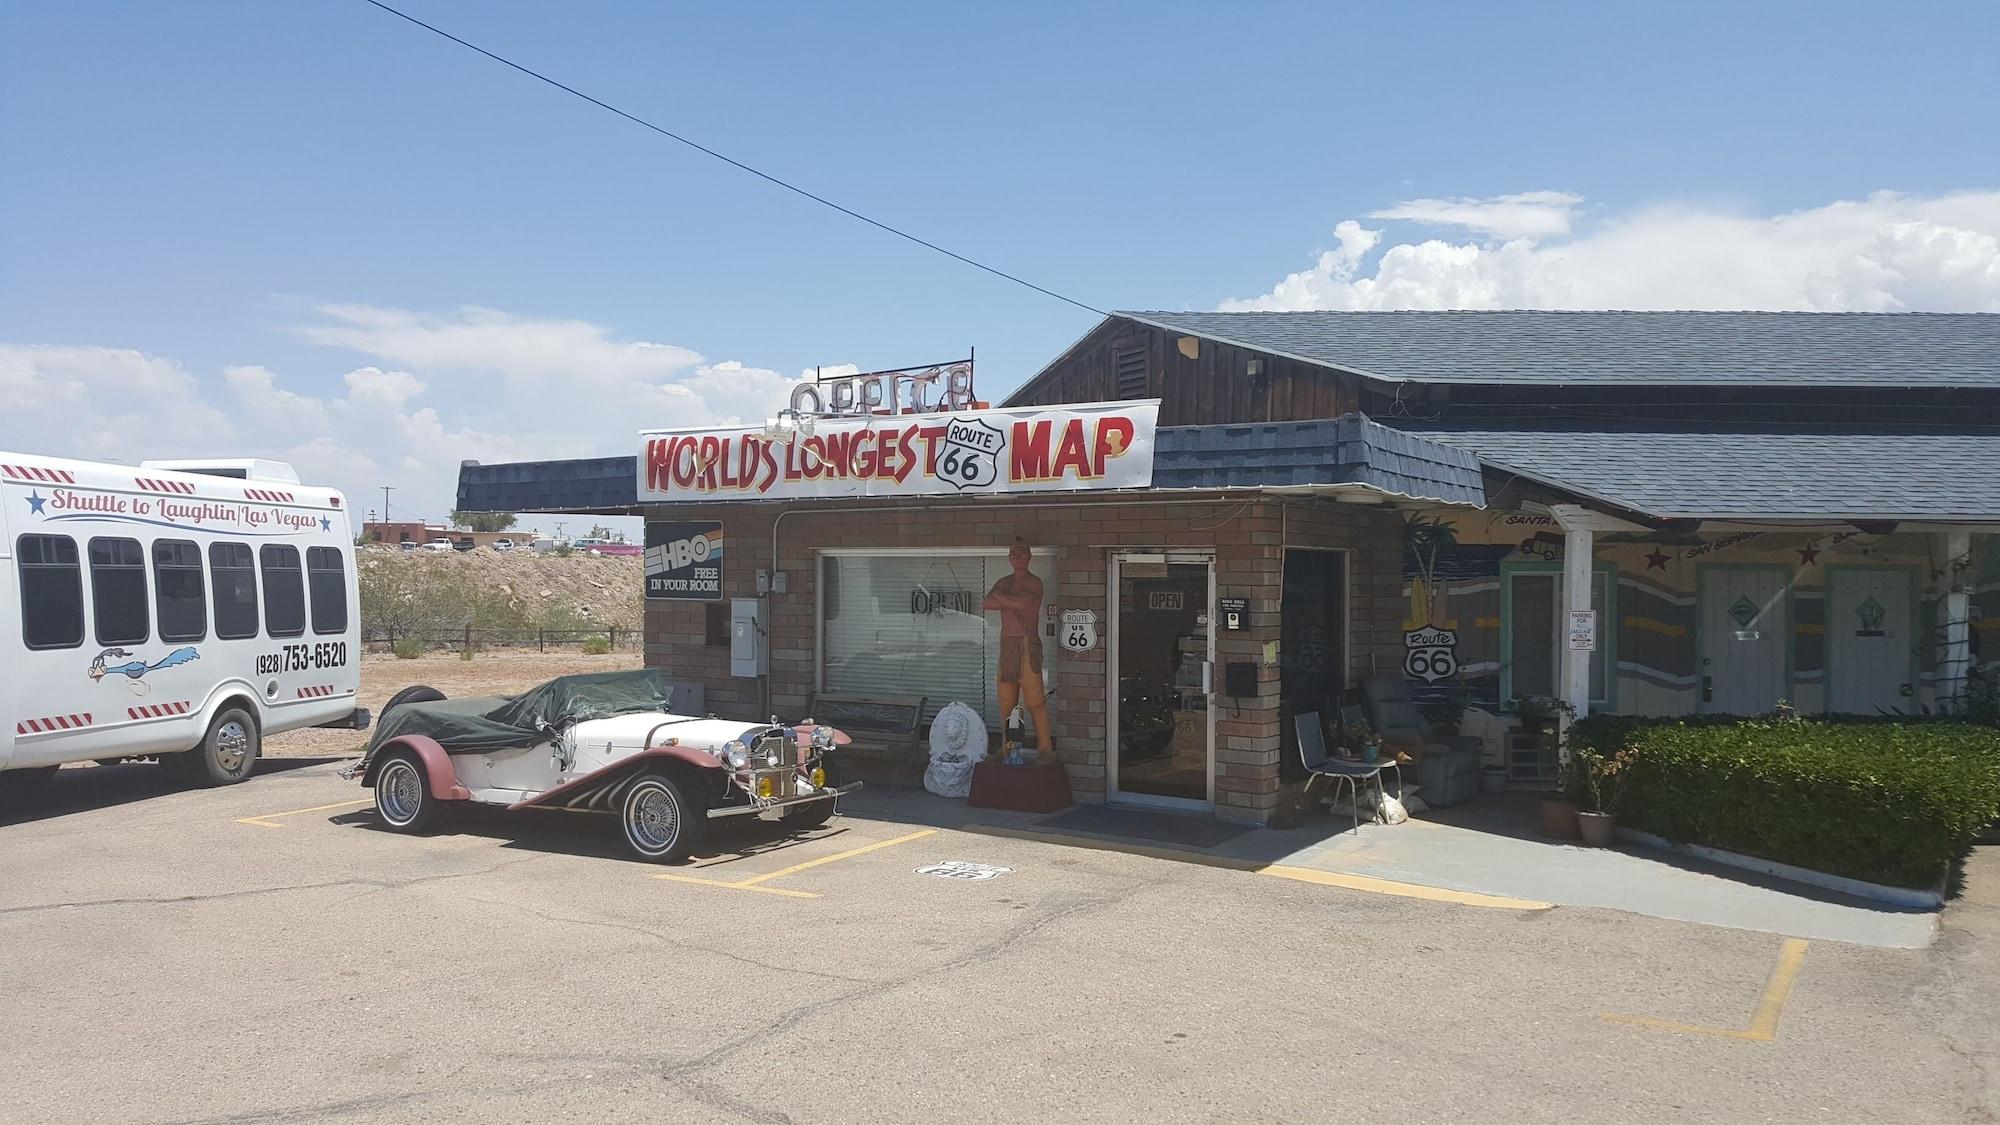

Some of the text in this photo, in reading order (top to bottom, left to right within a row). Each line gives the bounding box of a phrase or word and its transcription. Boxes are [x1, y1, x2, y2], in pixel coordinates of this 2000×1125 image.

[950, 426, 994, 449] ROUTE
[1008, 416, 1135, 482] MAP
[784, 423, 948, 485] LONGEST
[943, 447, 980, 481] 66
[51, 489, 127, 513] Shuttle
[132, 498, 151, 515] to
[270, 508, 317, 531] Vegas
[660, 534, 711, 572] HBO
[694, 567, 718, 579] FREE
[650, 579, 719, 592] IN YOUR ROOM
[1151, 593, 1181, 608] OPEN
[1067, 614, 1089, 623] ROUTE
[1068, 632, 1088, 647] 66
[1409, 632, 1451, 645] Route
[1409, 649, 1451, 676] 66
